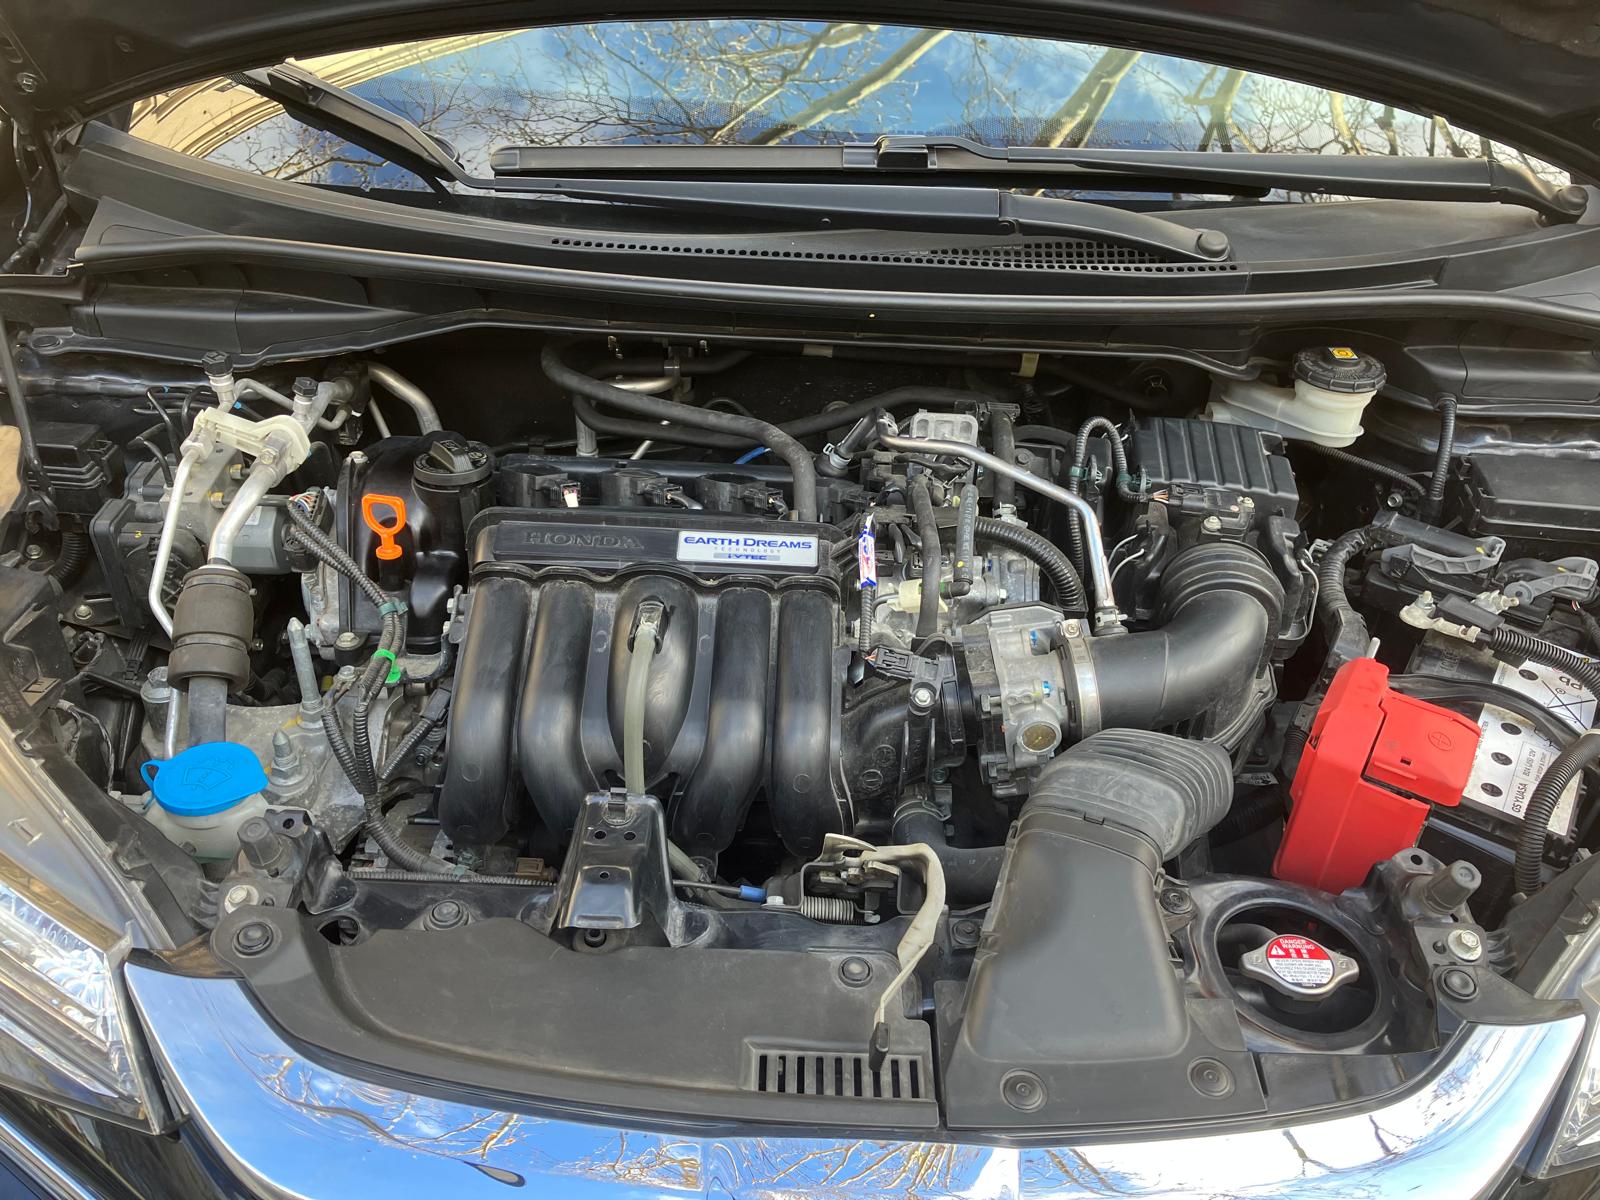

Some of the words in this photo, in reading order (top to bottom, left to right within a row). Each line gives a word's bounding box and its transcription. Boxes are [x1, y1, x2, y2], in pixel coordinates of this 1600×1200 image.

[522, 532, 645, 550] HONDA
[684, 536, 740, 547] EARTH
[714, 546, 781, 554] TECHNOLOGY
[1515, 783, 1528, 803] YUASA
